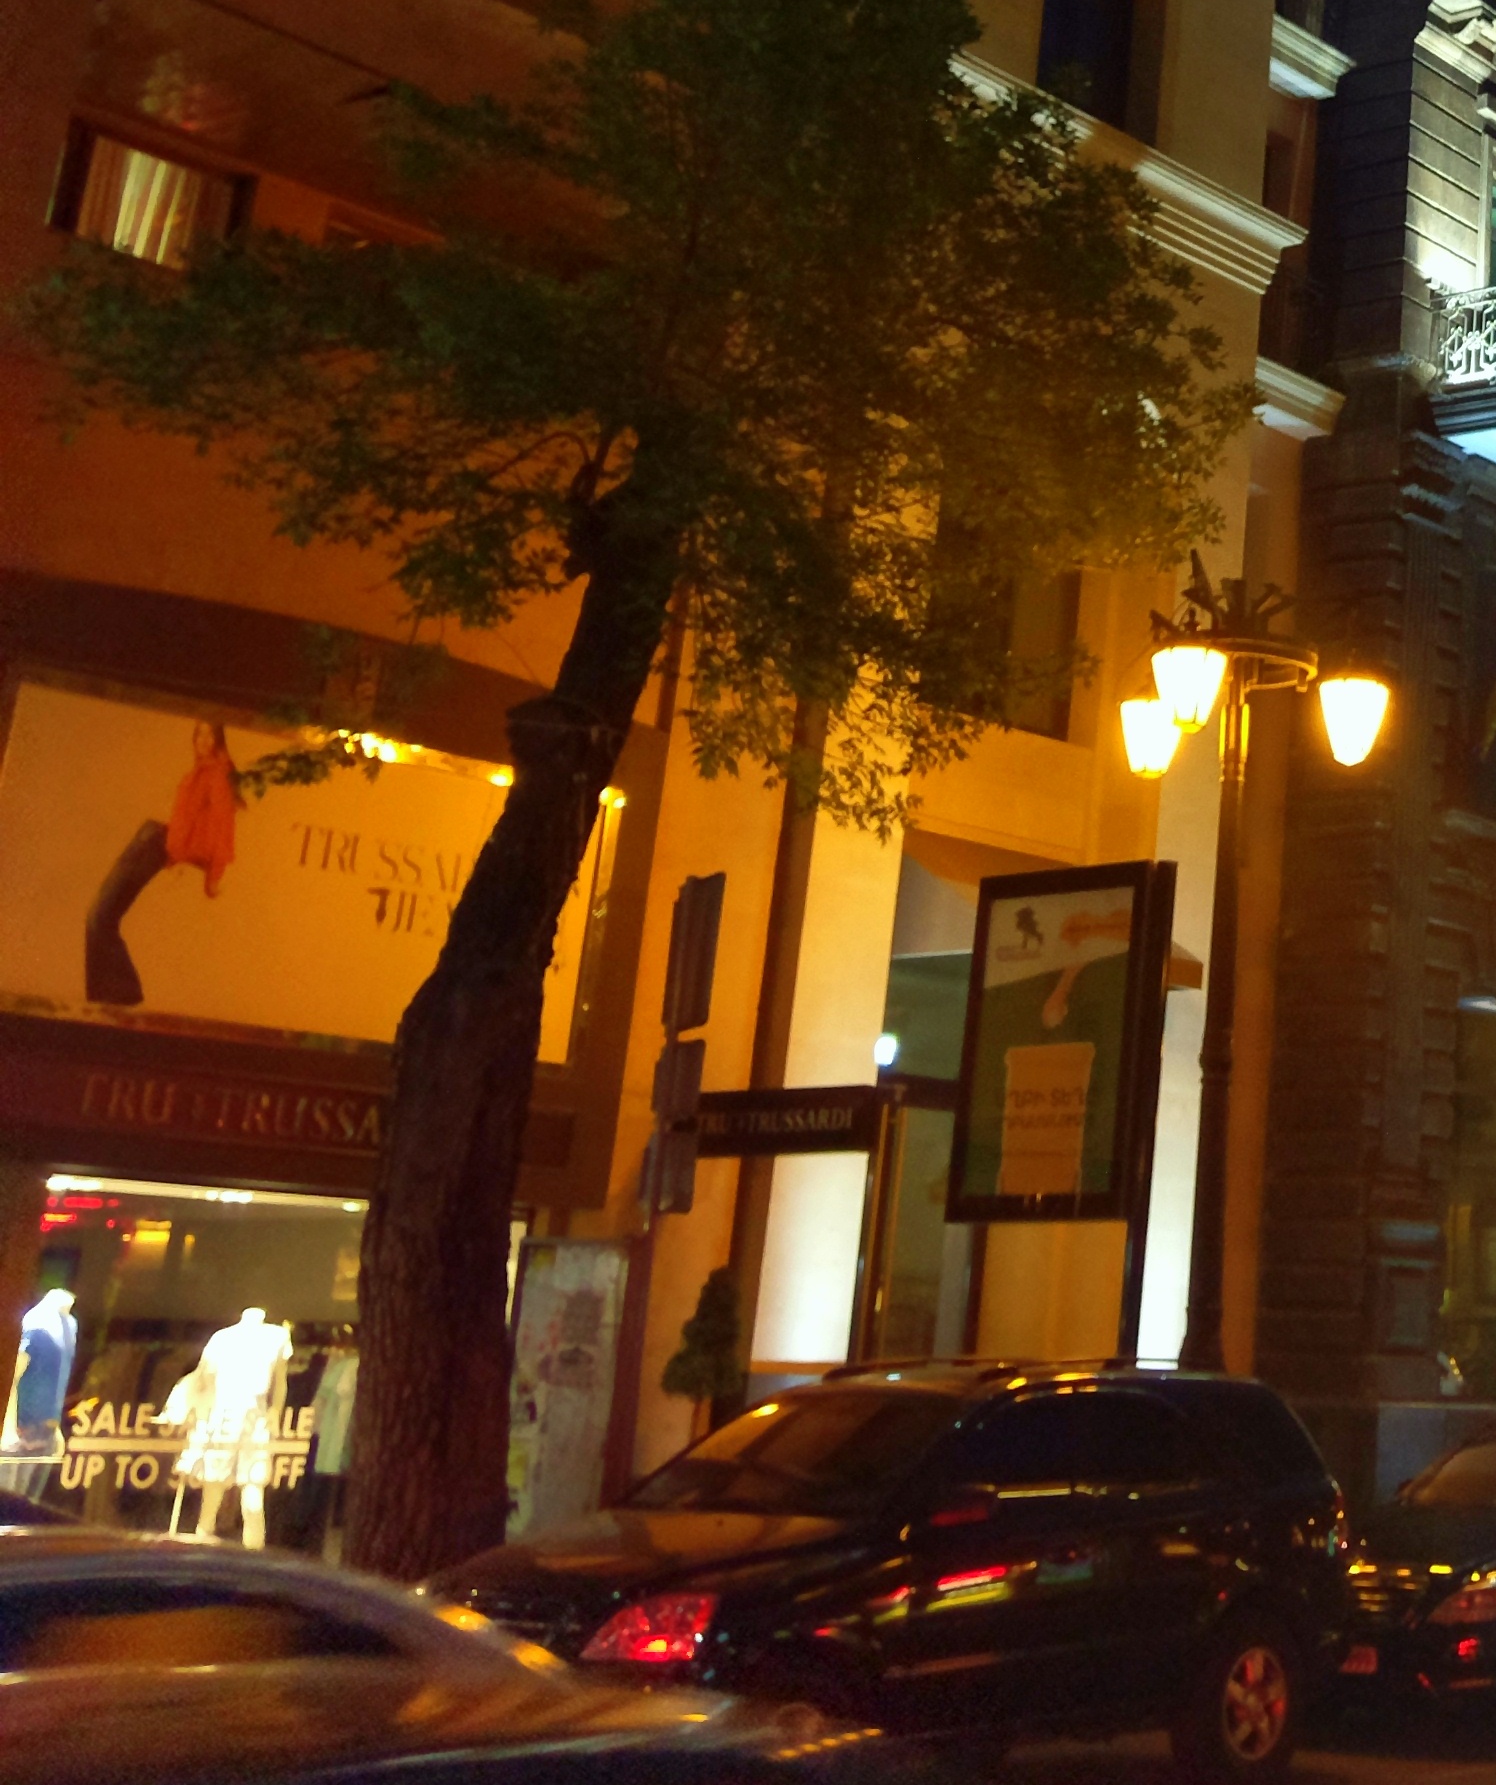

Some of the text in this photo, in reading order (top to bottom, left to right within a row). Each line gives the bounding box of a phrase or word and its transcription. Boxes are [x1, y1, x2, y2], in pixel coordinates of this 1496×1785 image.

[750, 1106, 854, 1134] TRUSSARDI
[71, 1400, 156, 1436] SALE
[59, 1453, 106, 1490] UP
[114, 1453, 160, 1490] TO
